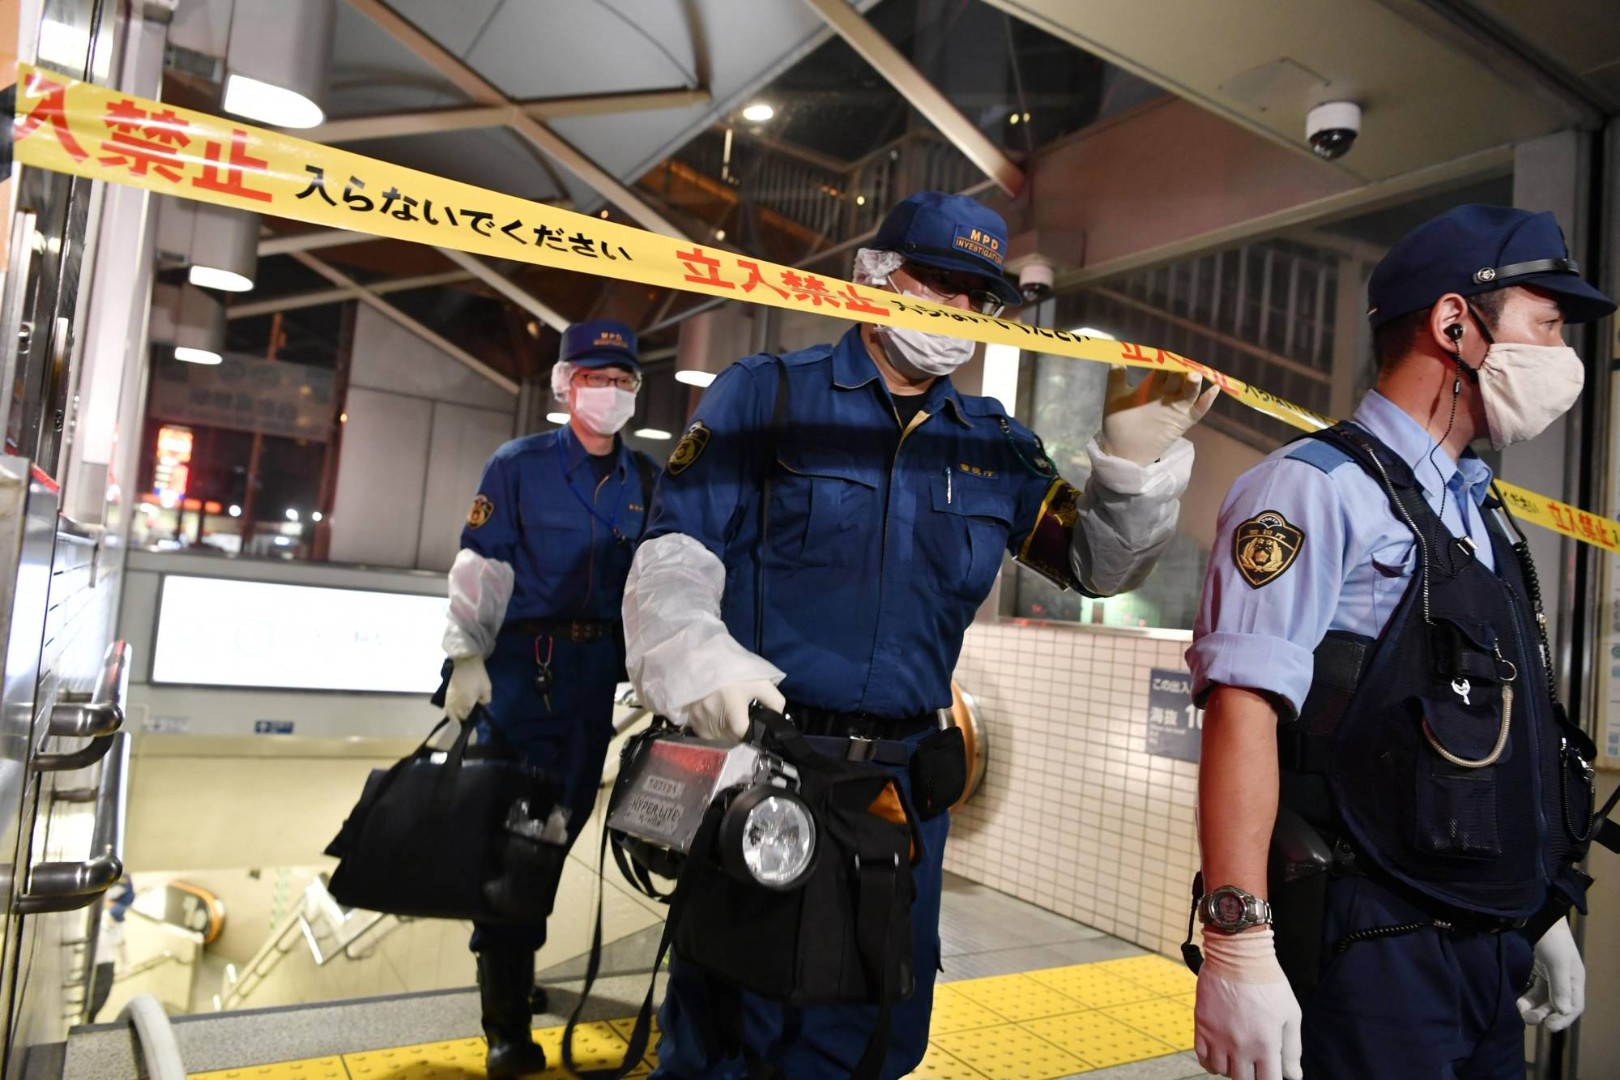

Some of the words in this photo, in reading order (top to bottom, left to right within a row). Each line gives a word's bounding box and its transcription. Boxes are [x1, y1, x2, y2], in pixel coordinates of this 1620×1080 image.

[295, 164, 633, 261] 入らないでください
[676, 247, 891, 317] 立入禁止
